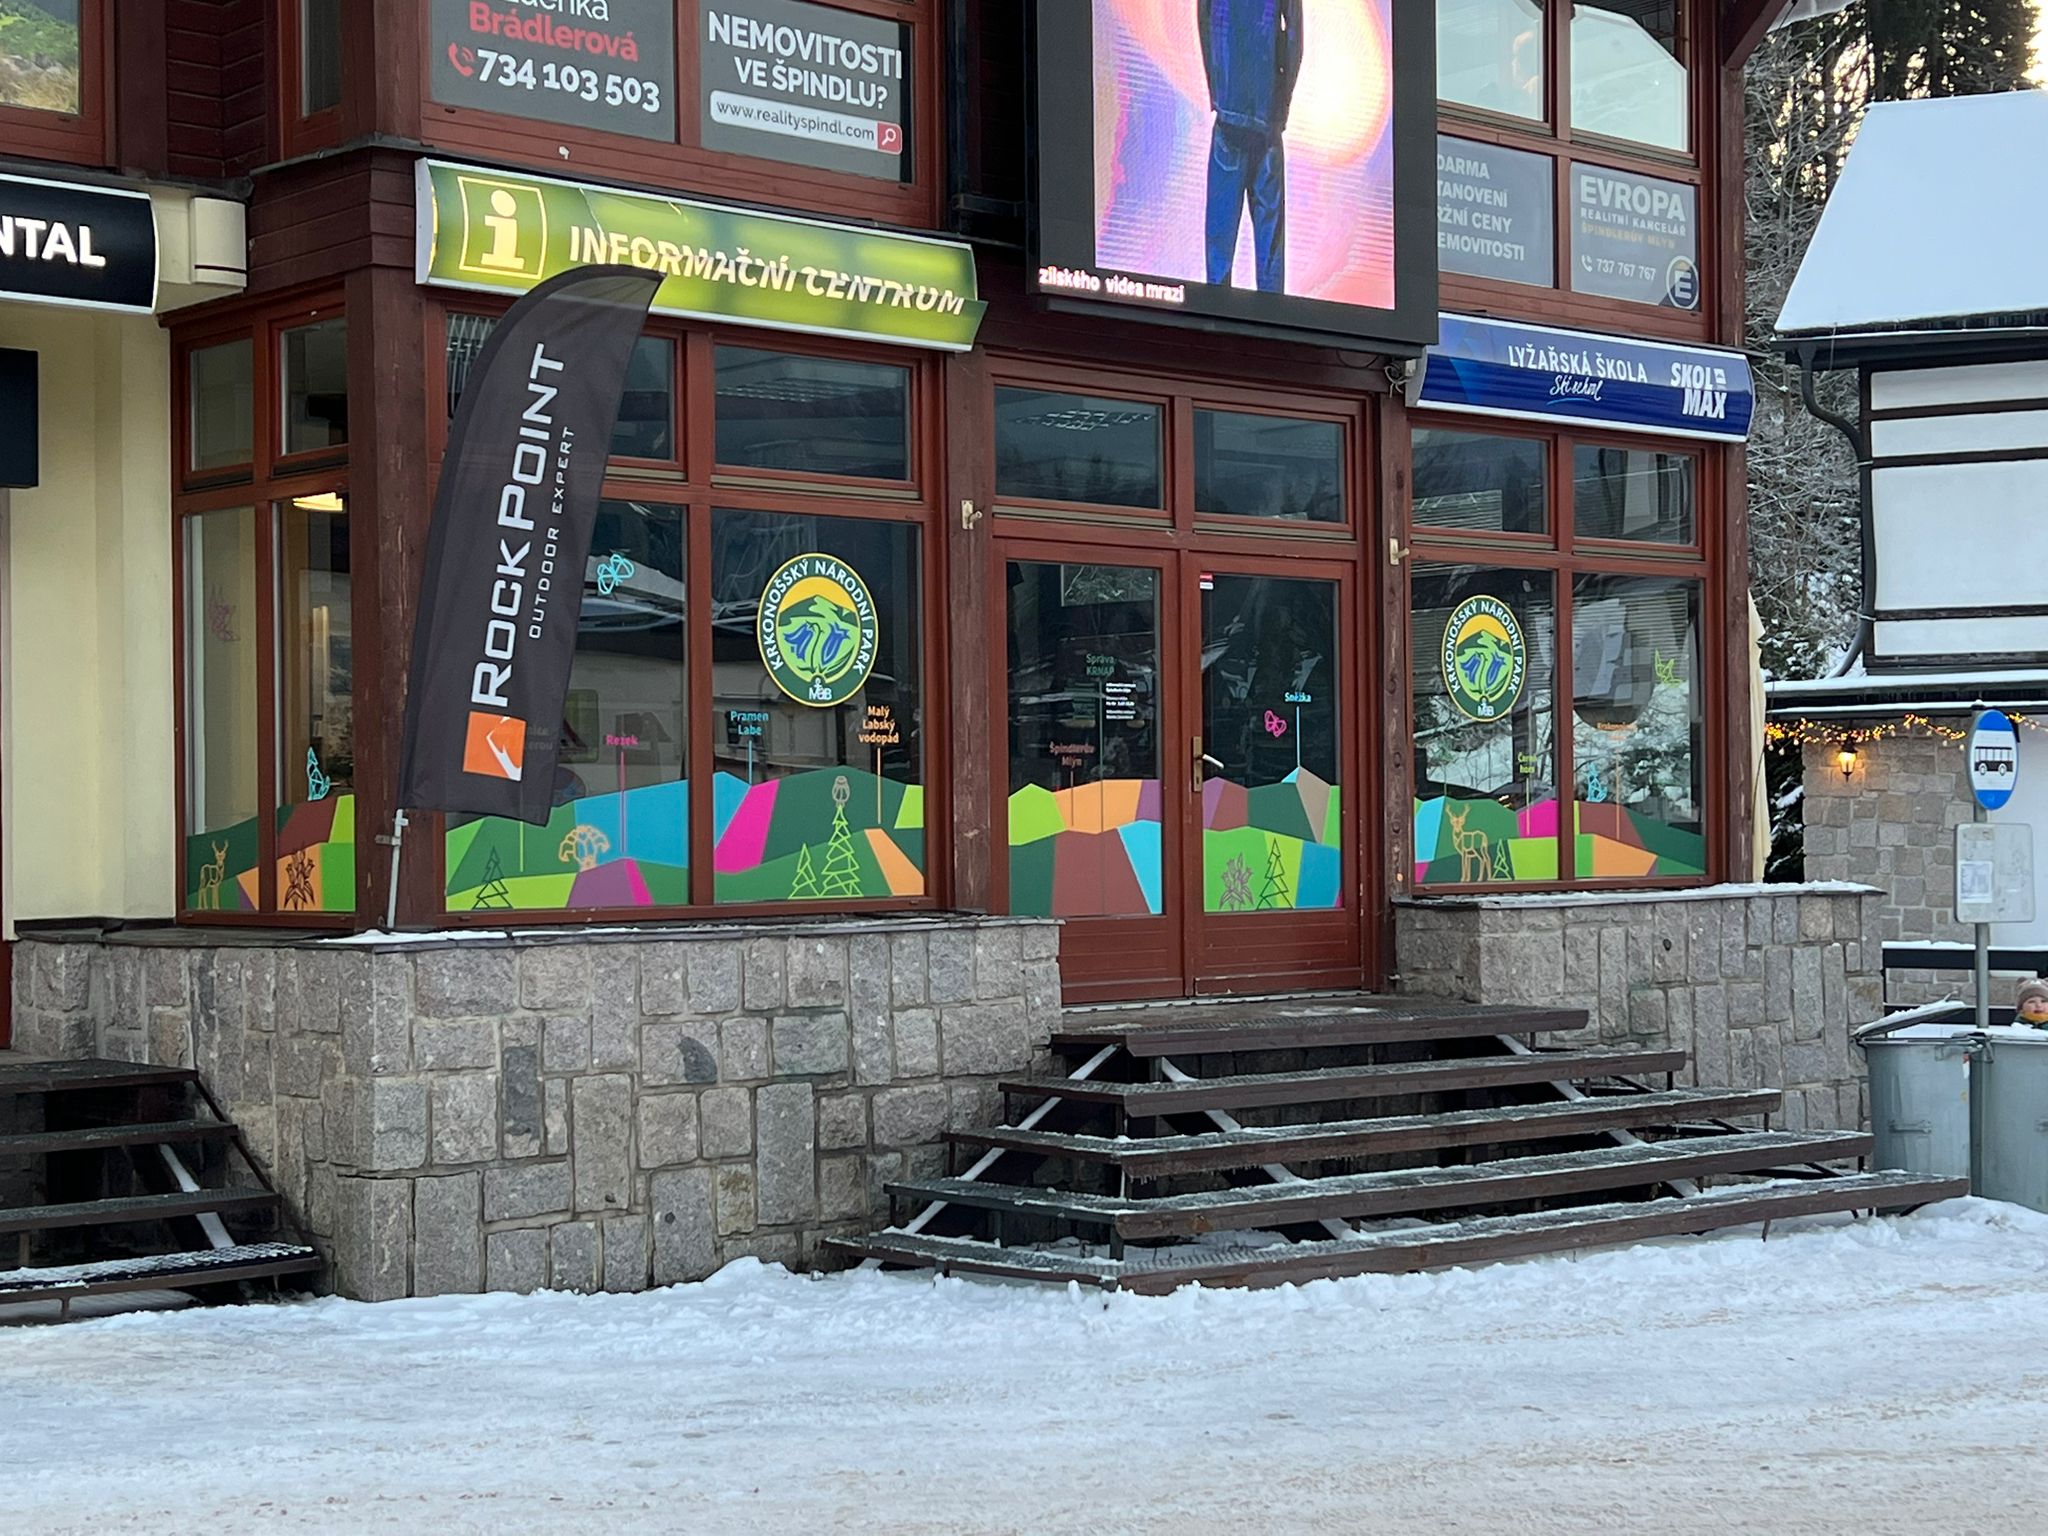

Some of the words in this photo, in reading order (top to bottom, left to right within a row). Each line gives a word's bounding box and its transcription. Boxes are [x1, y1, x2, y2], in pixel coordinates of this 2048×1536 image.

[469, 2, 639, 62] Brádlerová
[708, 11, 903, 79] NEMOVITOSTI
[477, 49, 537, 90] 734
[542, 62, 599, 101] 103
[605, 74, 661, 113] 503
[734, 56, 768, 88] VE
[772, 58, 888, 110] ŠPINDLU?
[716, 101, 875, 141] www.realityspindl.com
[1580, 174, 1686, 222] EVROPA
[1472, 212, 1512, 234] CENY
[569, 225, 798, 292] INFORMAČNÍ
[800, 265, 965, 316] CENTRUM
[1105, 274, 1145, 298] videa
[1596, 258, 1615, 274] 737
[1618, 261, 1635, 277] 767
[1638, 265, 1656, 281] 767
[1508, 344, 1592, 377] LYŽAŘSKÁ
[1597, 352, 1648, 384] ŠKOLA
[1682, 388, 1728, 420] MAX
[528, 528, 560, 639] OUTDOOR
[551, 426, 575, 515] EXPERT
[815, 559, 874, 622] NÁRODNÍ
[852, 629, 874, 675] PARK
[1481, 600, 1523, 650] NÁRODNÍ
[1508, 656, 1523, 695] PARK
[730, 711, 769, 722] Pramen
[737, 725, 762, 736] Labe
[606, 734, 638, 746] Rezek
